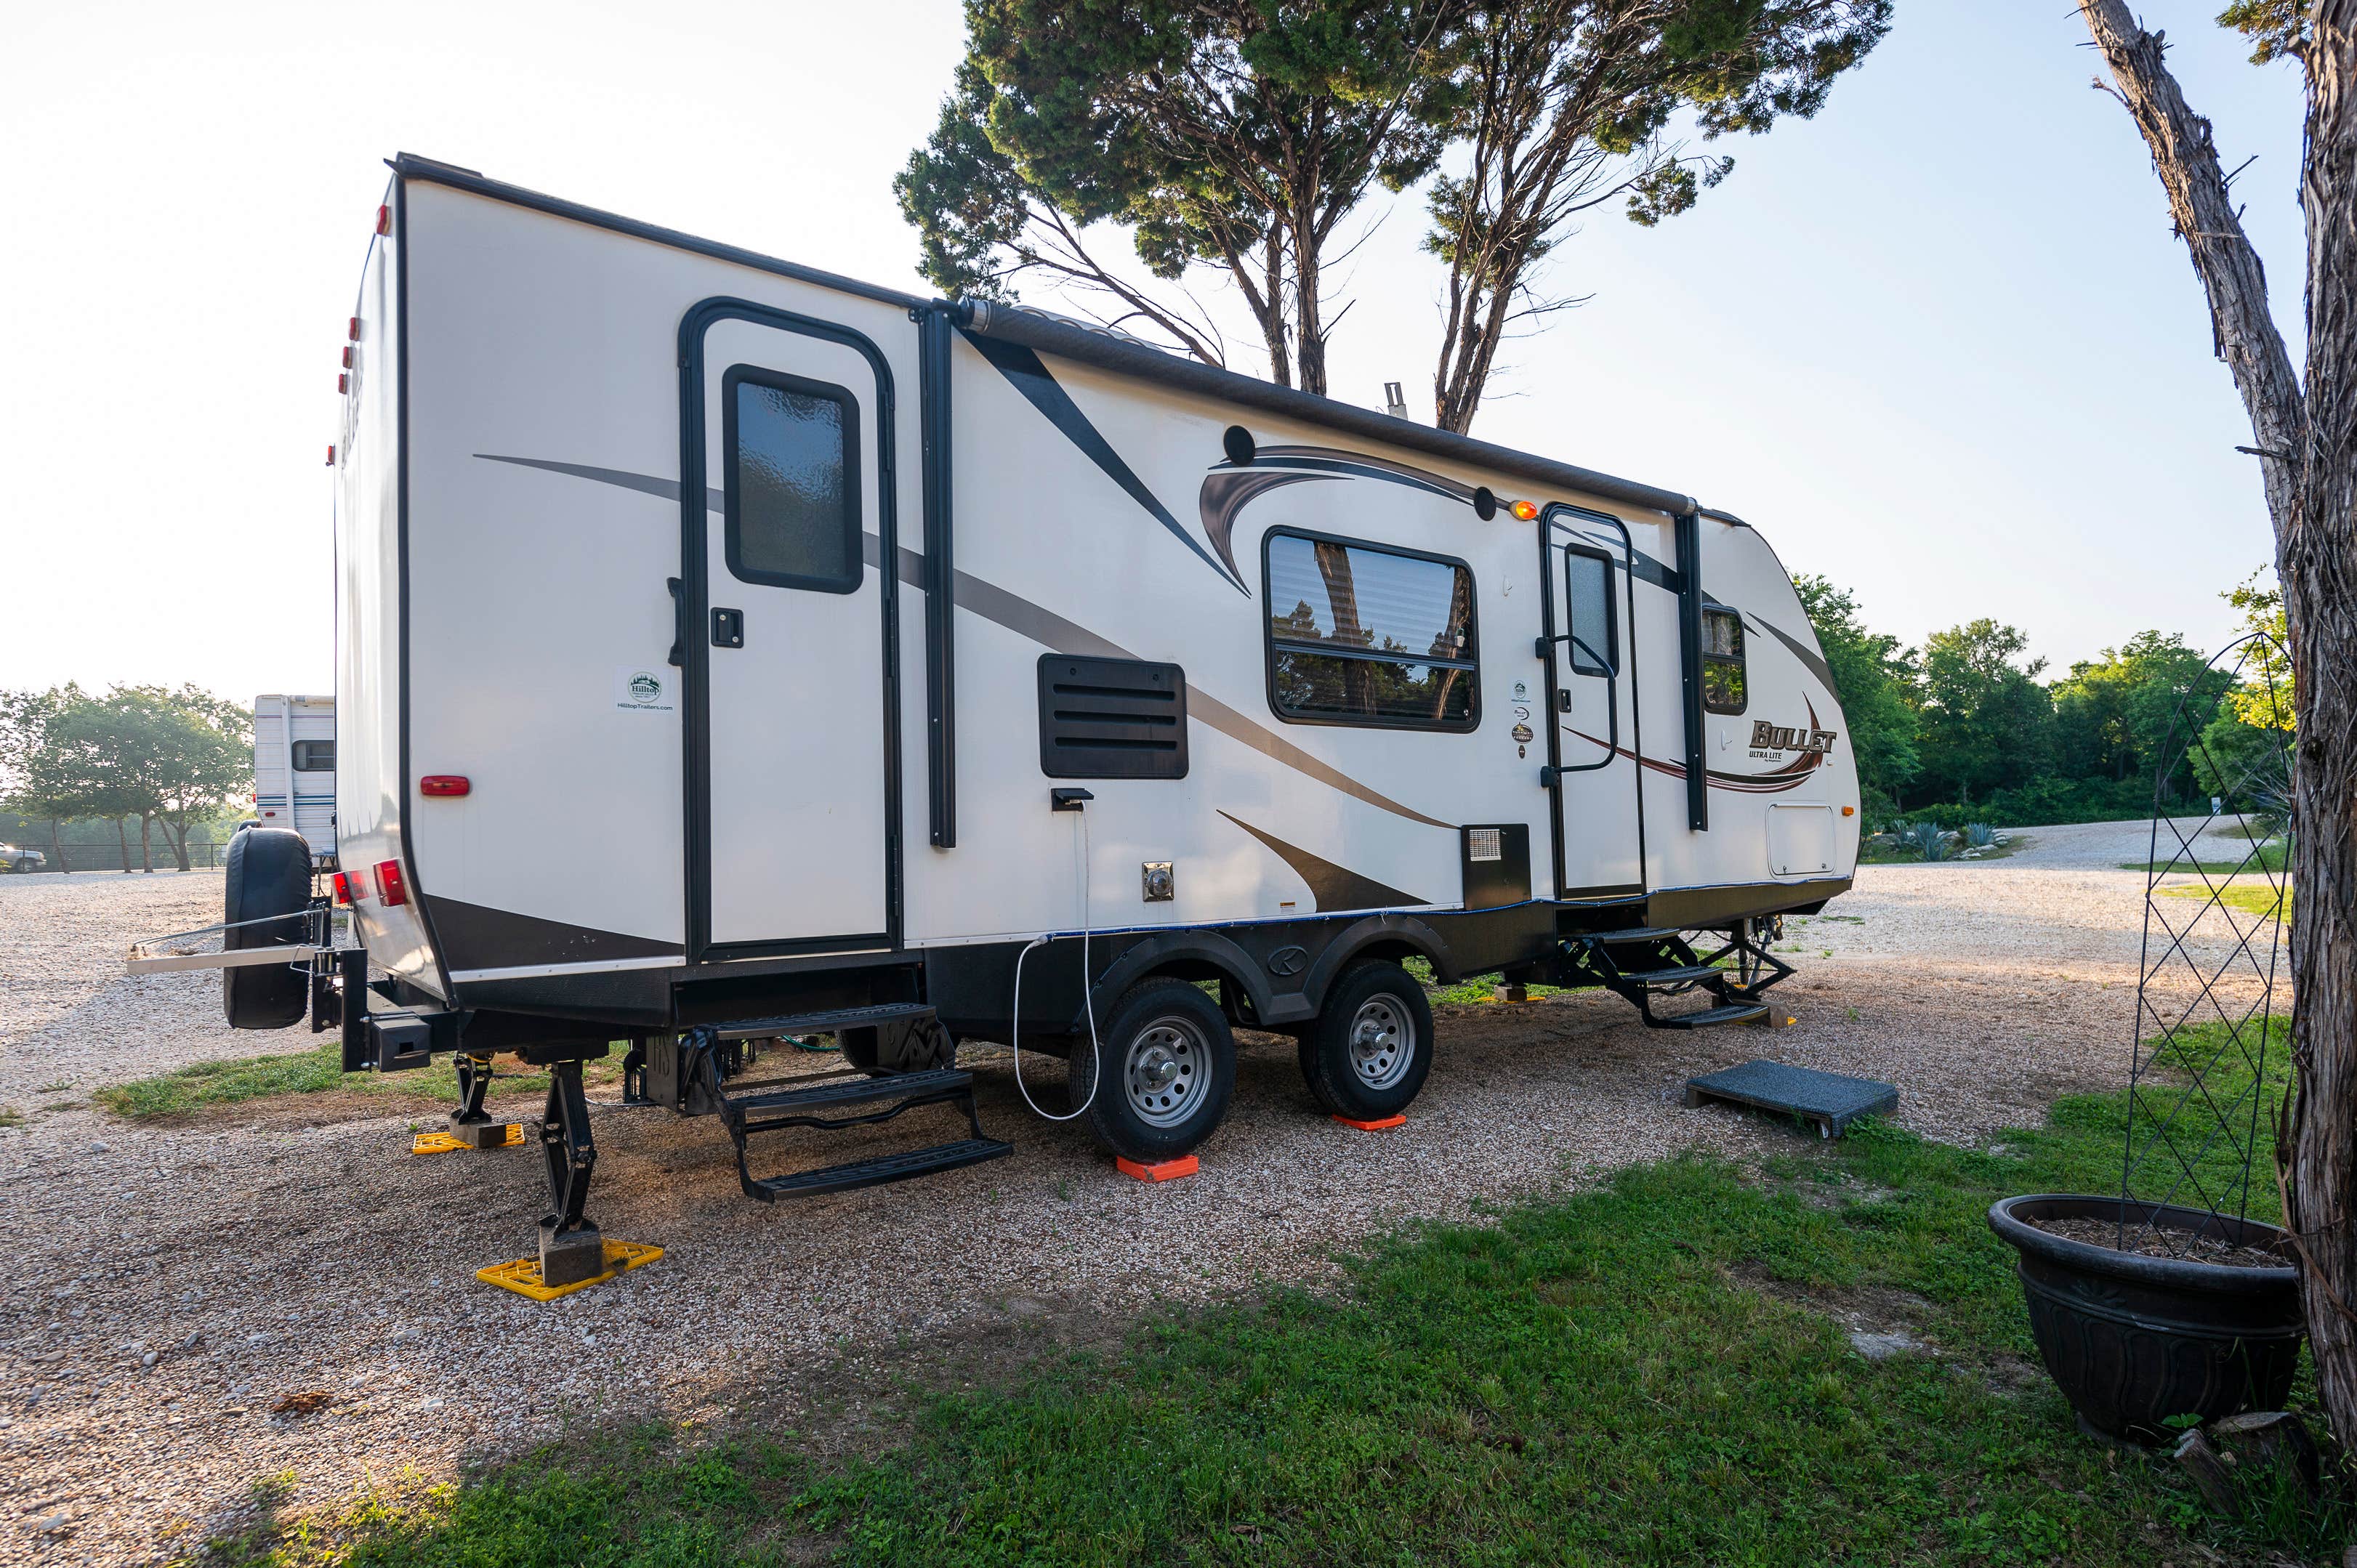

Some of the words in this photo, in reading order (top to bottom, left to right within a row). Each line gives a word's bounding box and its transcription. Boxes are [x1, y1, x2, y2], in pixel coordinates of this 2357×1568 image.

[632, 685, 659, 695] Hilltop
[1749, 720, 1837, 753] BULLET
[1768, 751, 1783, 760] LITE
